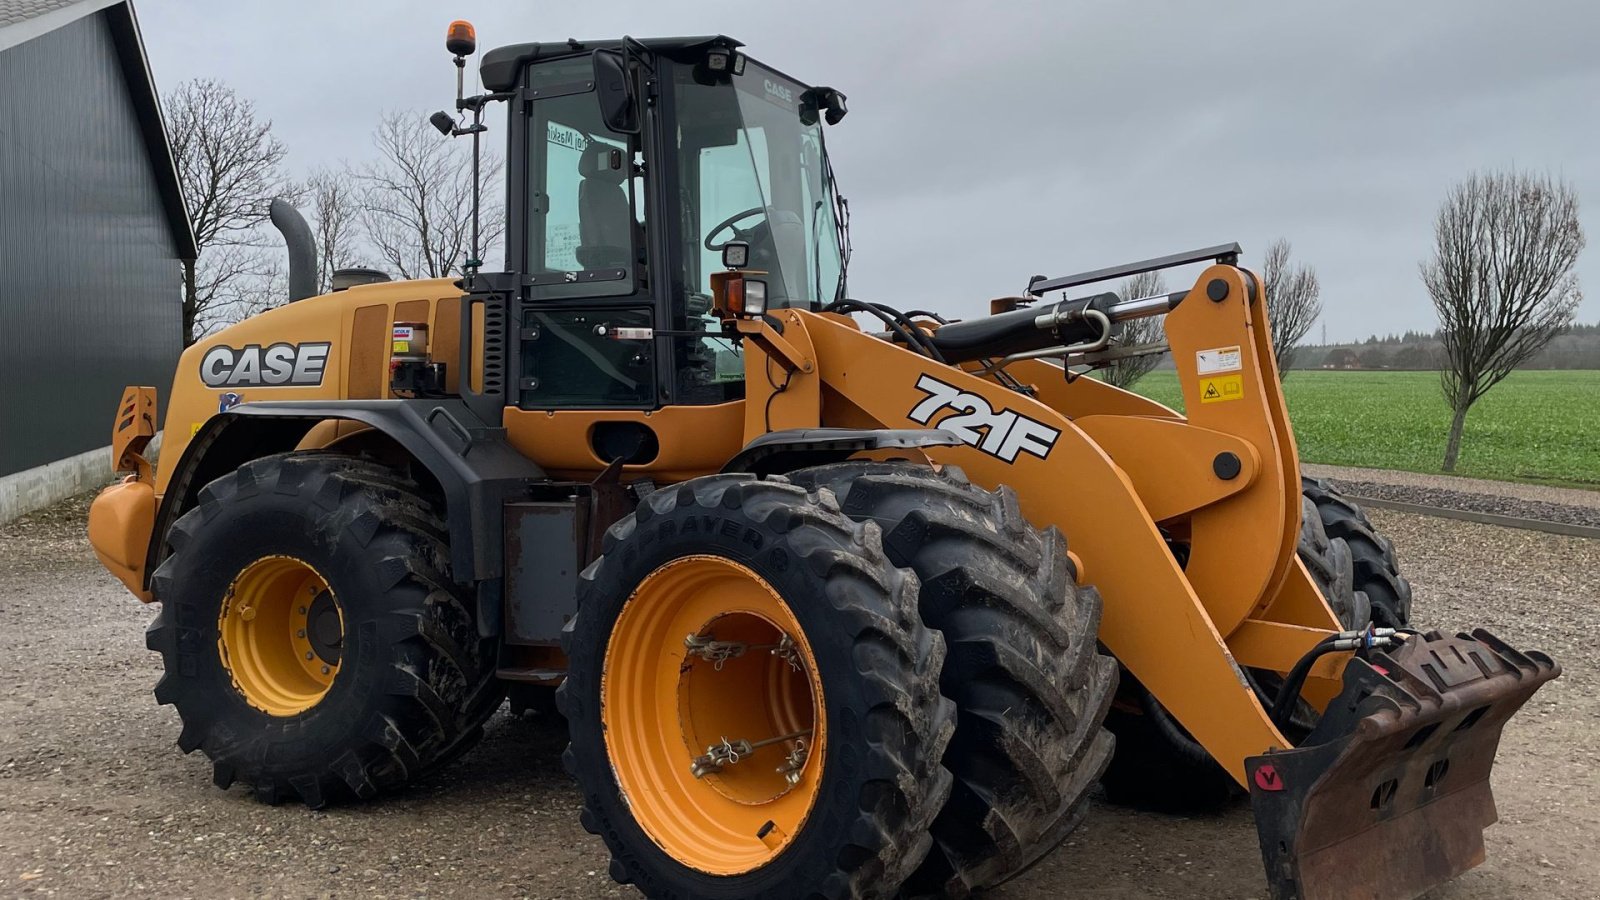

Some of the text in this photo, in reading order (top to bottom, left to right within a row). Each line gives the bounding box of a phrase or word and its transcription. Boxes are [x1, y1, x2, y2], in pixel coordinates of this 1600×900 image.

[764, 79, 792, 103] CASE
[200, 345, 329, 386] CASE
[906, 372, 1062, 465] 721F
